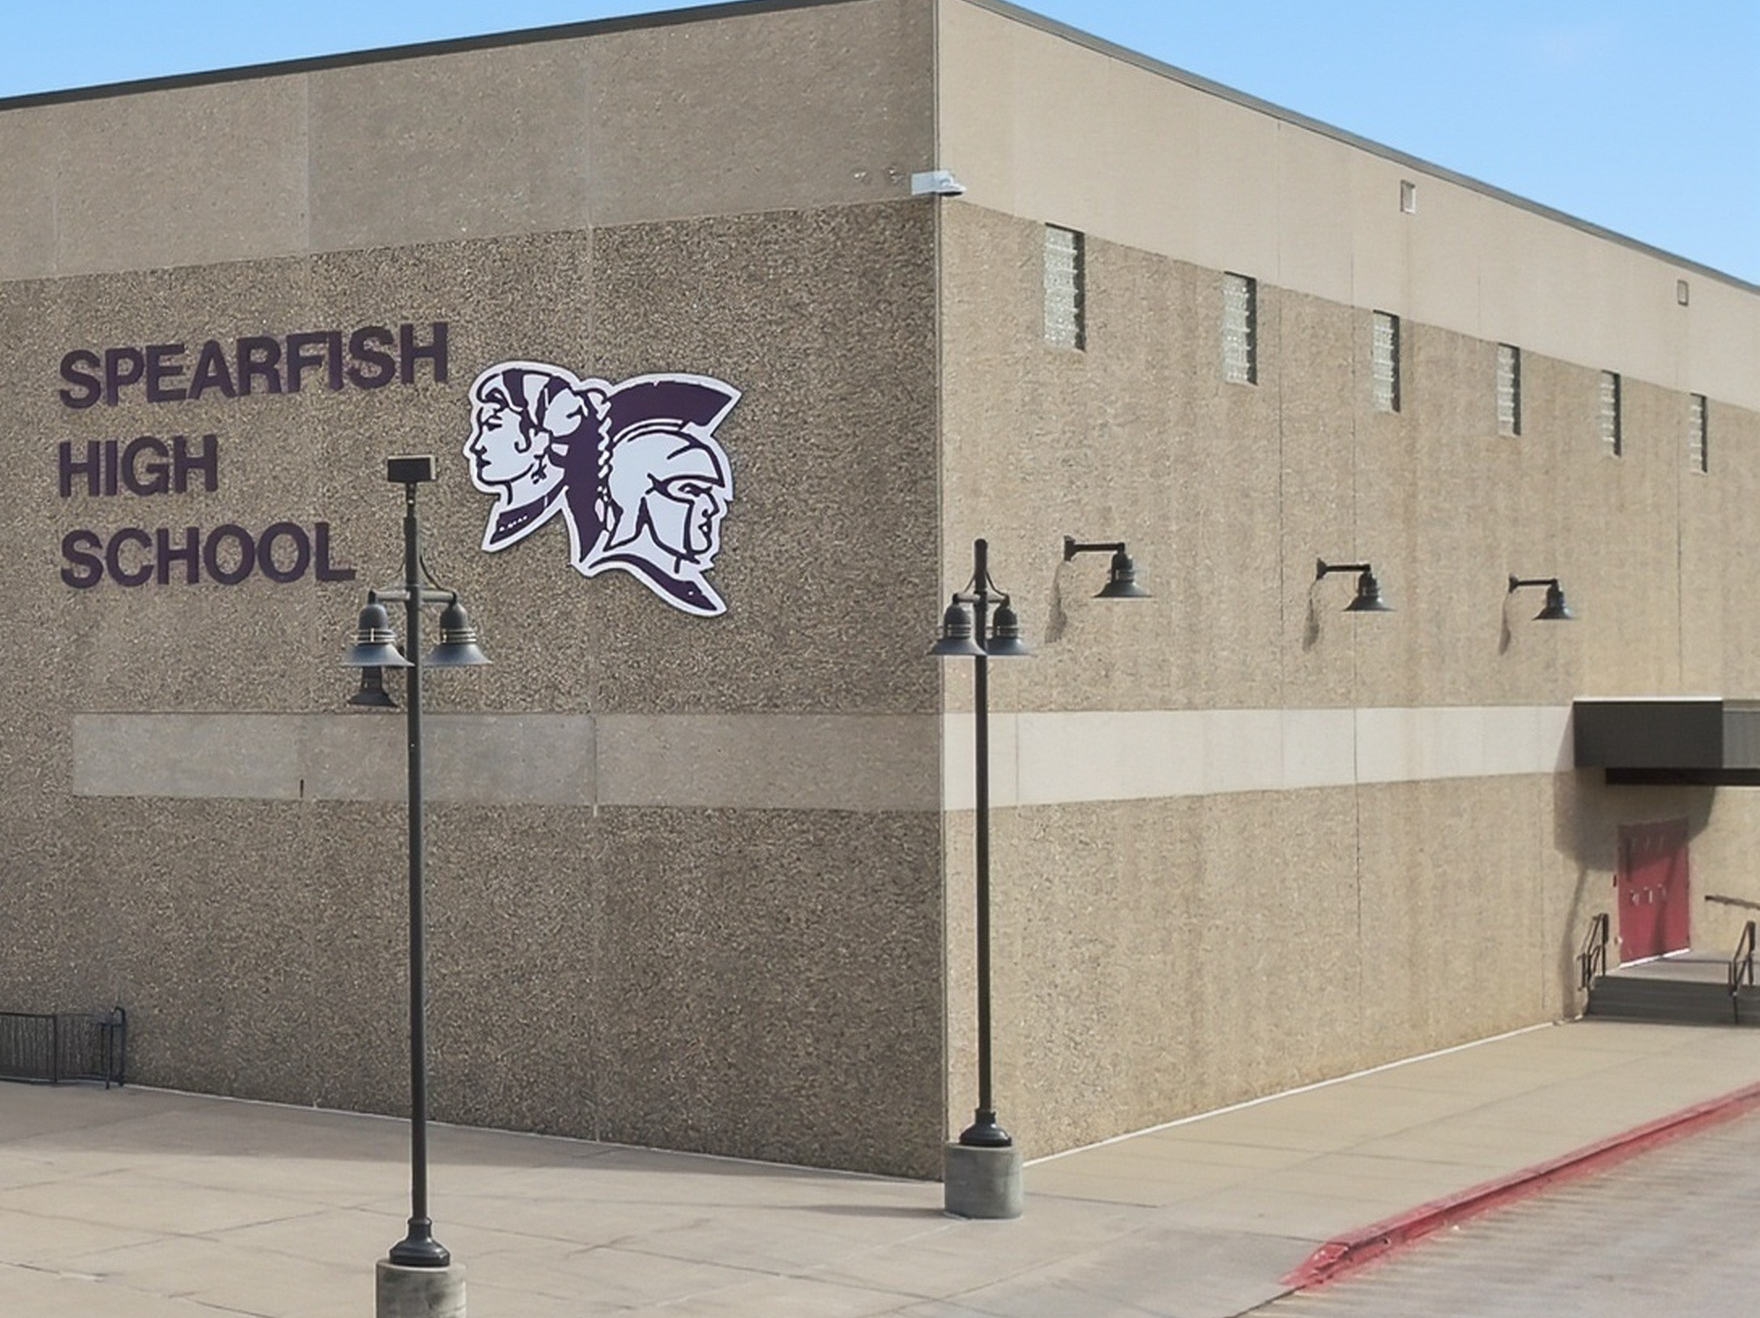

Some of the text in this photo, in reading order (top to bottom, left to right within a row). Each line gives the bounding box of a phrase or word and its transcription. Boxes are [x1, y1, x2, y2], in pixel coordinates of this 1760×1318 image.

[59, 322, 448, 409] SPEARFISH
[59, 434, 218, 498] HIGH
[60, 522, 356, 589] SCHOOL
